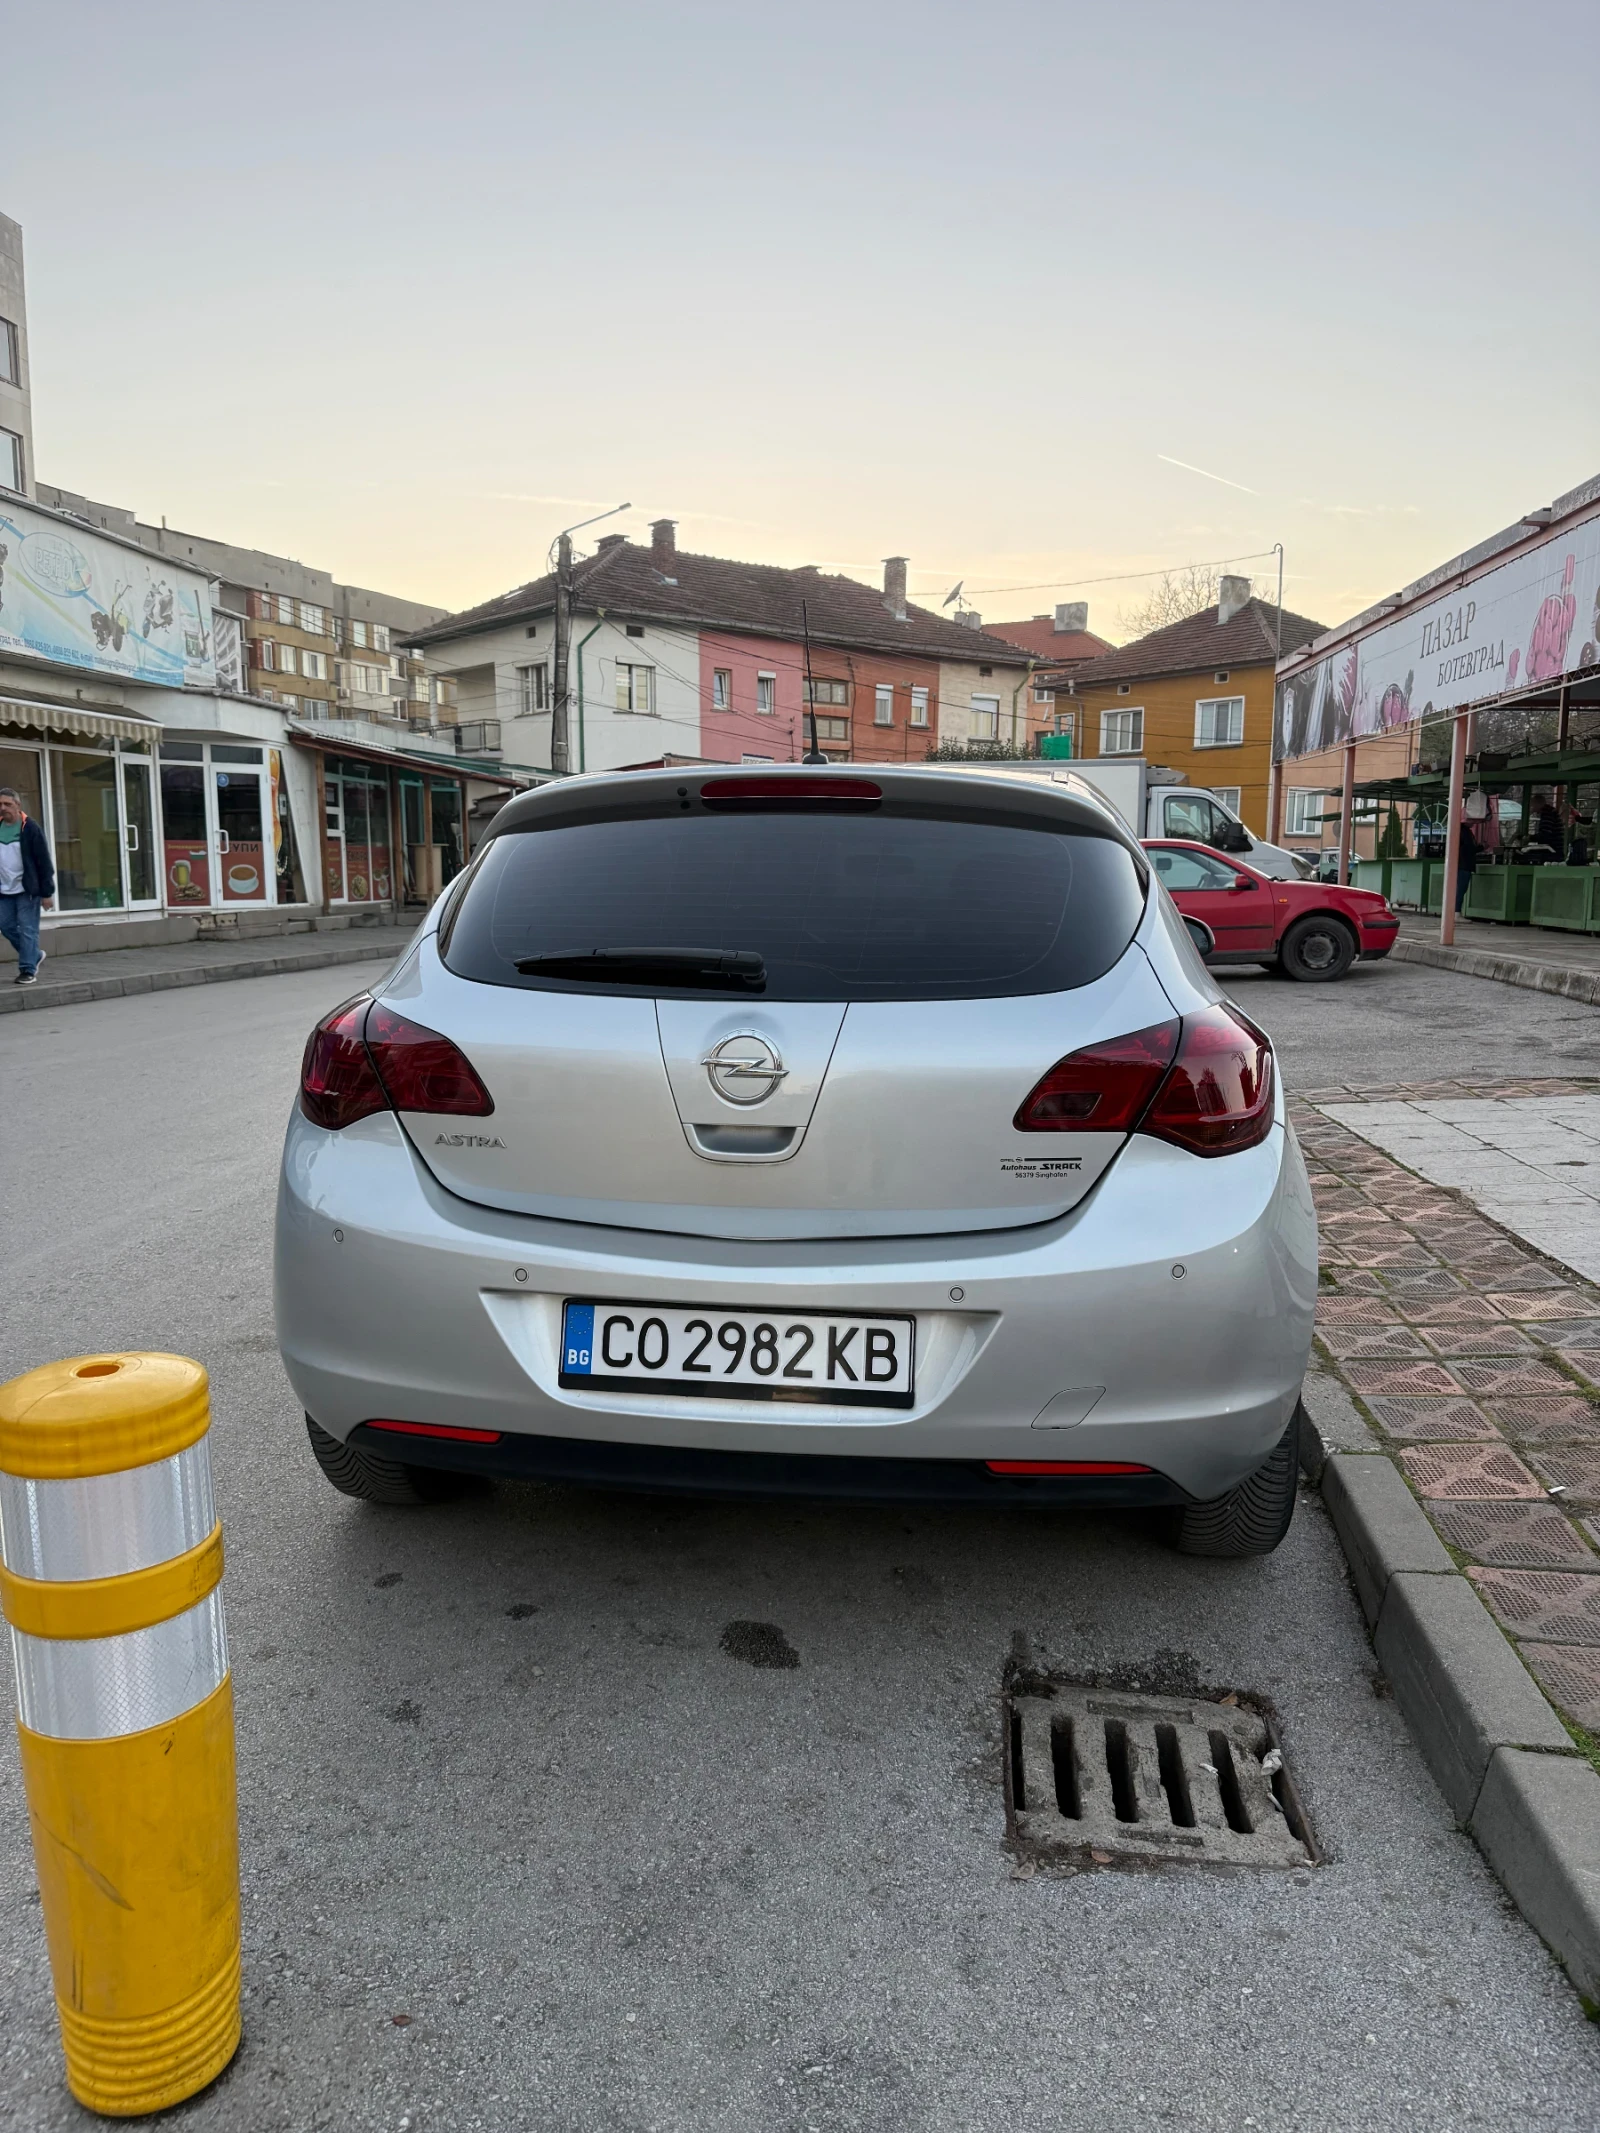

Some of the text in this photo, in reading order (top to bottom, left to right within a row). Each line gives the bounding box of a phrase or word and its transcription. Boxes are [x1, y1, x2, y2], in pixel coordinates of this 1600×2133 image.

[1419, 601, 1476, 659] ПАЗАР
[1436, 639, 1504, 687] БОТЕВГРАД
[434, 1132, 507, 1149] ASTRA
[1040, 1163, 1082, 1171] STRACK
[567, 1348, 590, 1366] BG
[602, 1314, 898, 1382] CO 2982 KB
